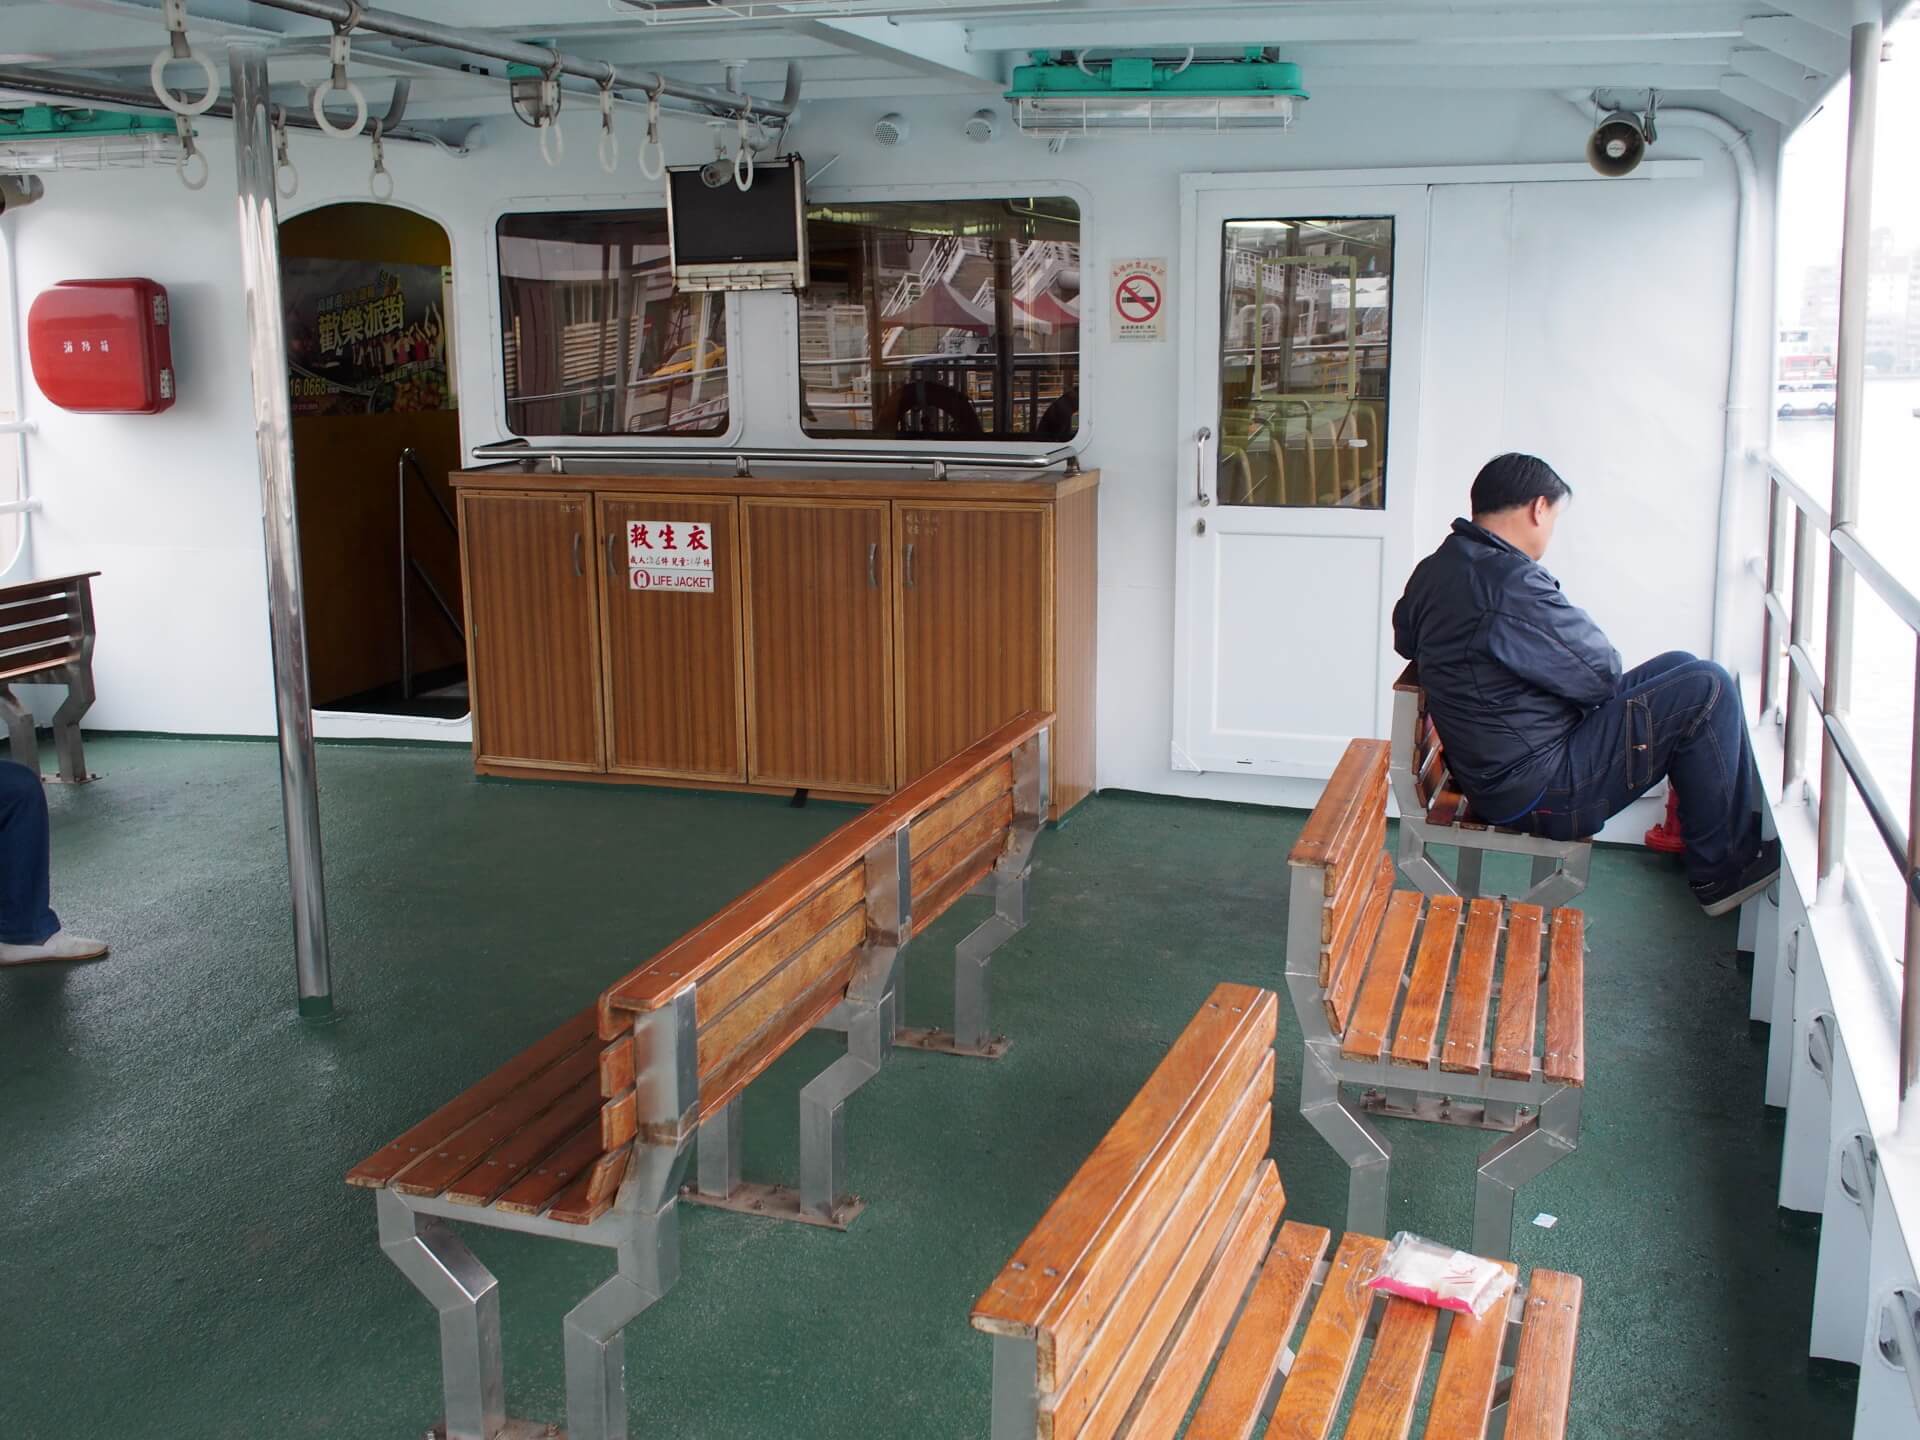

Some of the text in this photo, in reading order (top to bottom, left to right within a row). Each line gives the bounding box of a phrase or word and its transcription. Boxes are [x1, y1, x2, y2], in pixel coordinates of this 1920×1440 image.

[319, 294, 404, 352] 歡樂派對
[630, 524, 709, 550] 救生衣
[652, 575, 712, 588] LIFE JACKET
